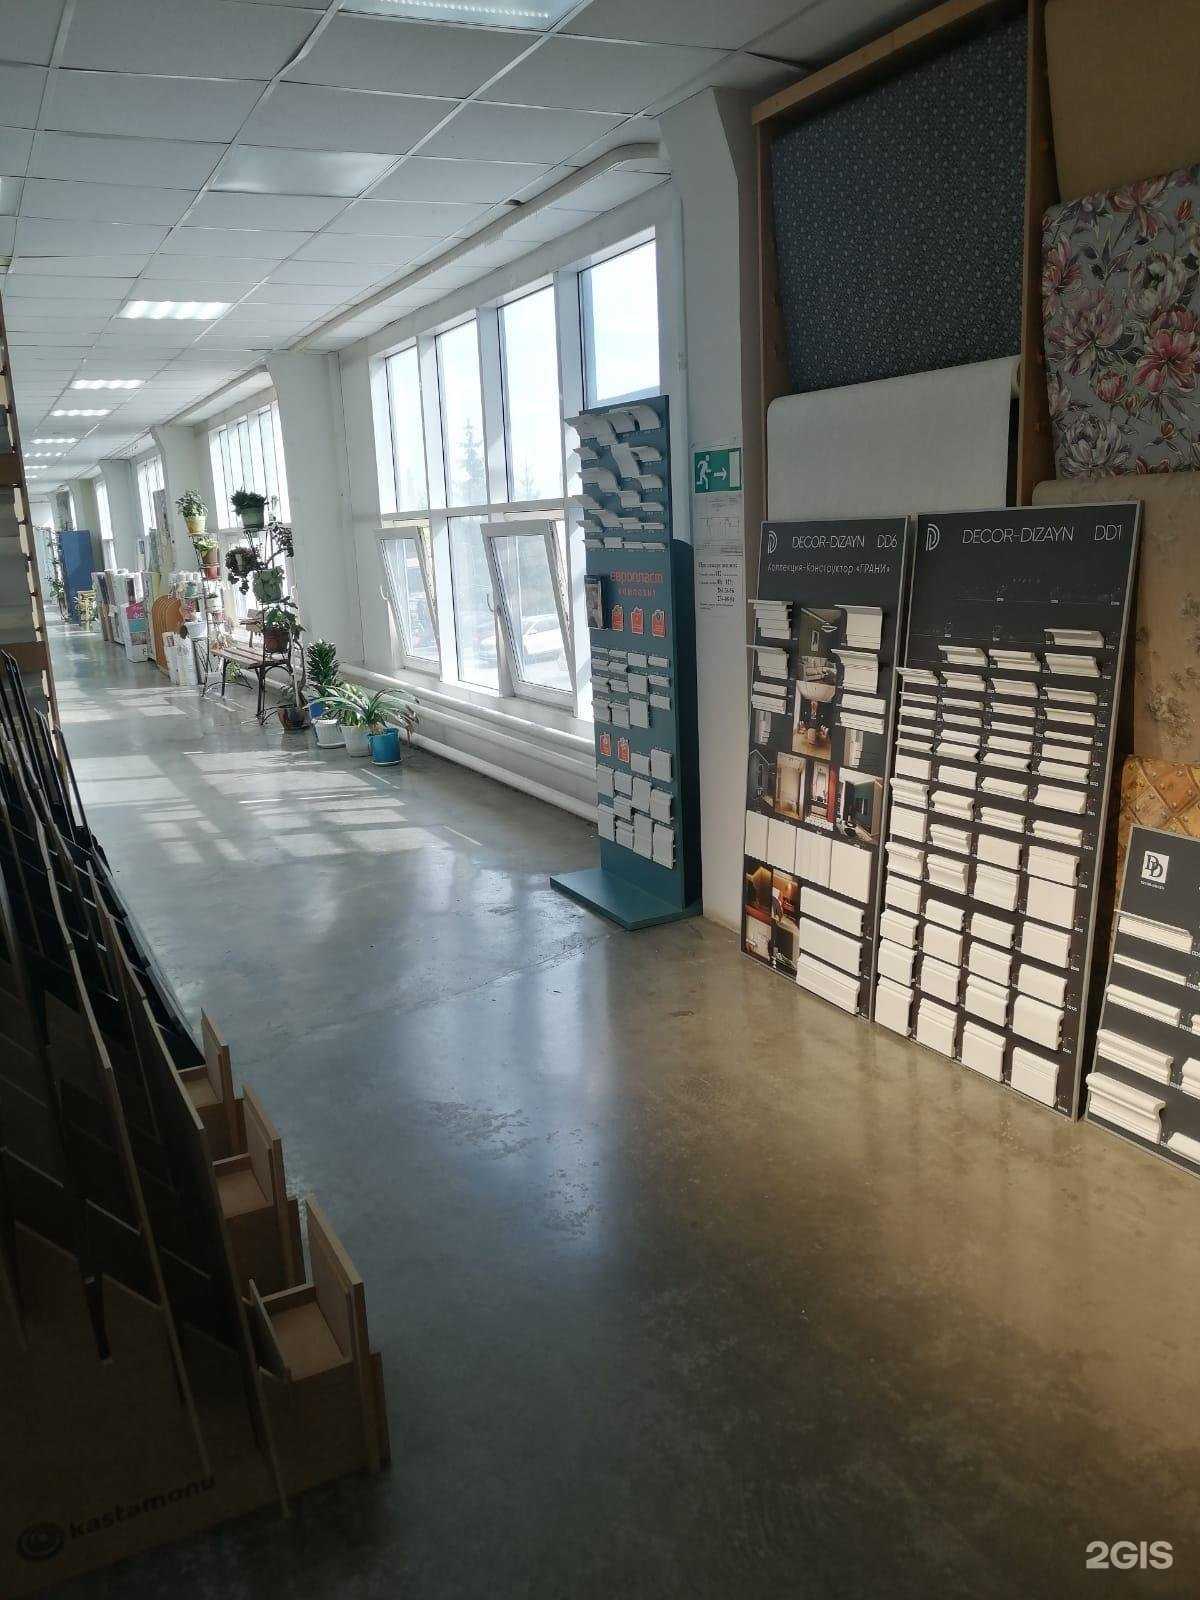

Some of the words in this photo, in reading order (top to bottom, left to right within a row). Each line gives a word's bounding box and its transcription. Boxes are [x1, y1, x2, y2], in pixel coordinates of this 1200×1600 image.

[791, 535, 865, 548] DECOR-DIZAYN
[962, 526, 1075, 544] DECOR-DIZAYN
[1094, 524, 1124, 541] DD1
[69, 1475, 216, 1540] kastamonu
